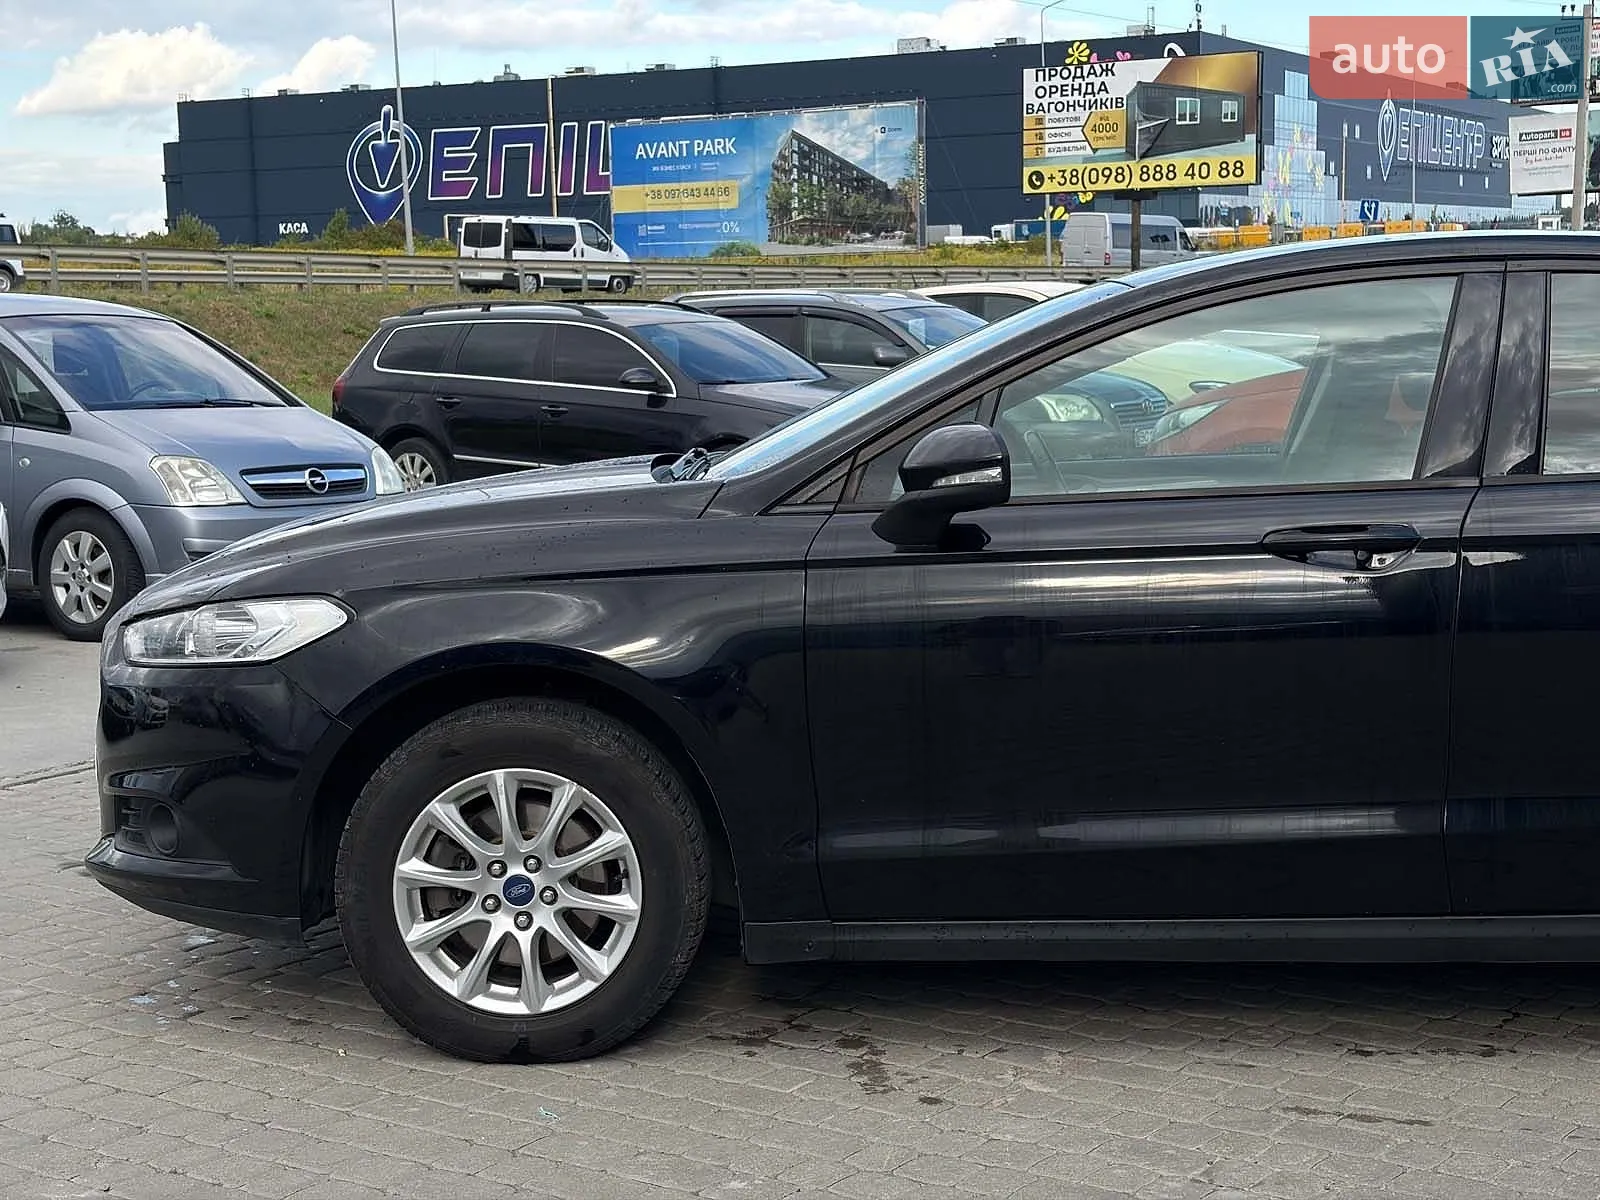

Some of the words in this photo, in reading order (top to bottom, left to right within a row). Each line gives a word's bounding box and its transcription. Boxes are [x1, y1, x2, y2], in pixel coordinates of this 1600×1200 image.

[1035, 62, 1116, 82] ПРОДАЖ
[1035, 81, 1109, 99] ОРЕНДА
[1026, 97, 1125, 115] ВАГОНЧИКІВ
[1047, 116, 1081, 124] ПОБУТОВІ
[1091, 122, 1119, 134] 4000
[1047, 131, 1072, 139] ОФІСНІ
[1397, 108, 1486, 168] ЕПІЦЕНТР
[1521, 131, 1556, 142] Autopark
[635, 140, 691, 160] AVANT
[693, 136, 737, 158] PARK
[1538, 147, 1550, 155] ПО
[1551, 146, 1576, 154] ФАКТУ
[1047, 165, 1133, 189] +38(098)
[1139, 163, 1177, 183] 888
[1183, 162, 1211, 180] 40
[1218, 160, 1245, 179] 88
[645, 189, 662, 200] +38
[664, 188, 681, 200] 097
[703, 187, 715, 197] 44
[279, 222, 309, 234] КАСА
